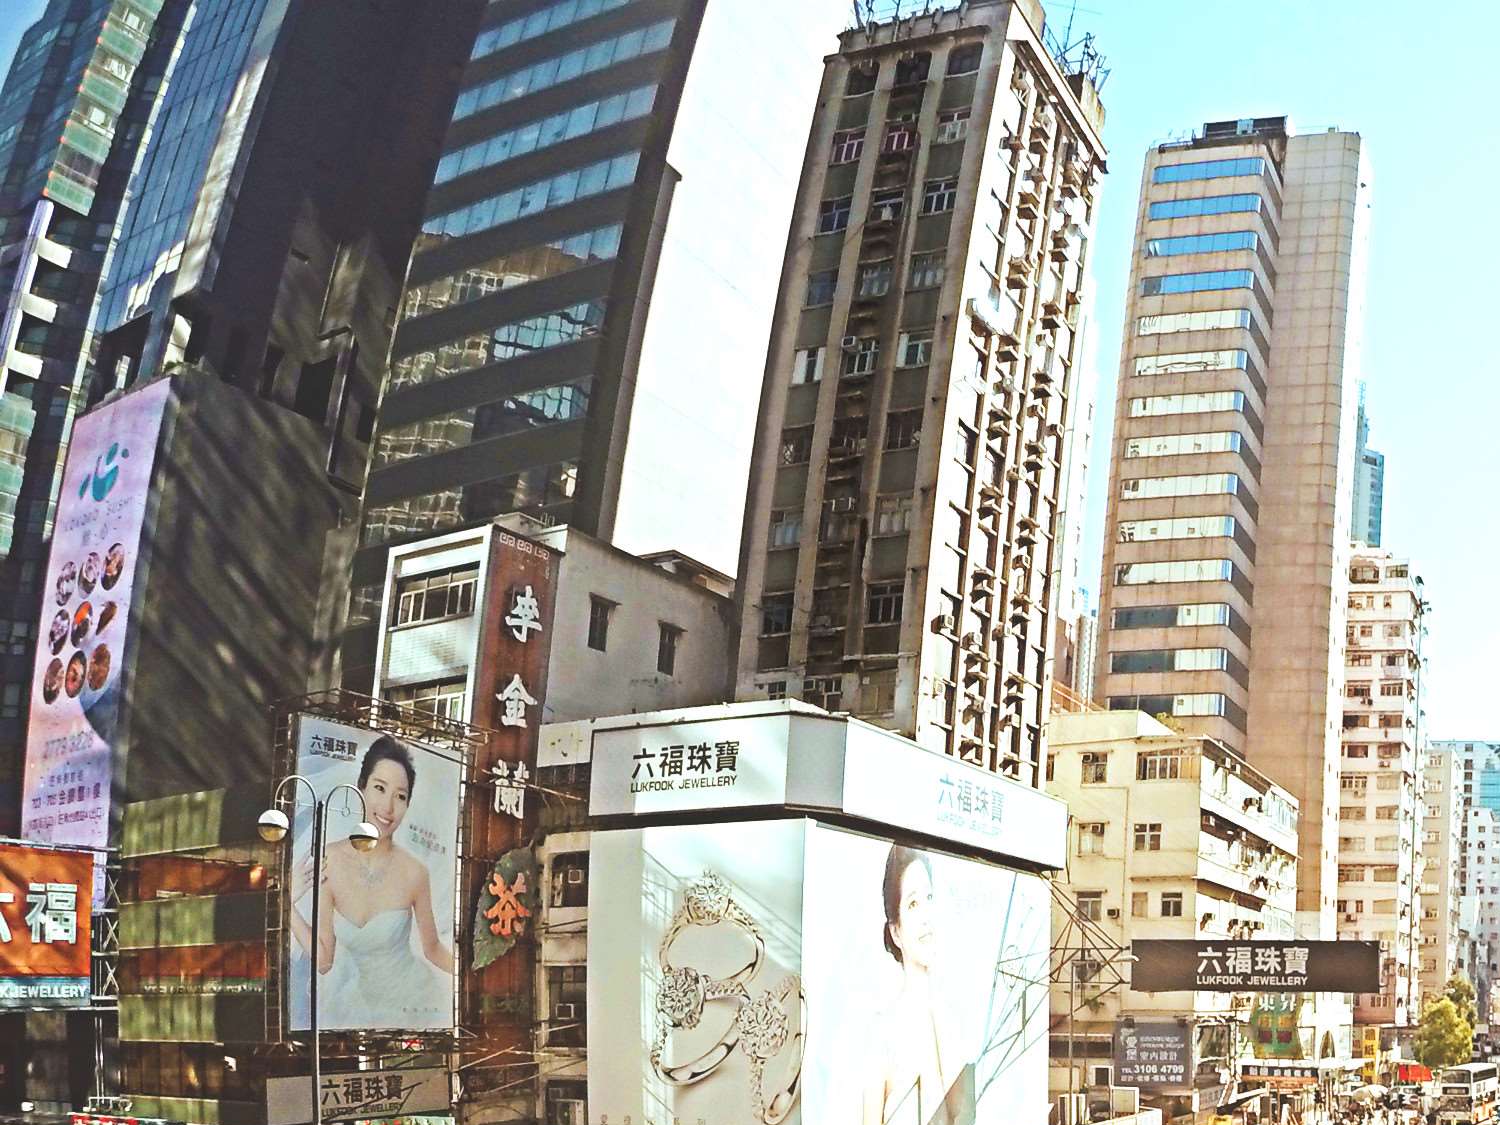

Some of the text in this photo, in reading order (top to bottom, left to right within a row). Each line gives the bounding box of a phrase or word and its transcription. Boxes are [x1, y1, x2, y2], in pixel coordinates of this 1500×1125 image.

[492, 586, 542, 820] 李金蘭
[310, 734, 358, 756] 六福珠寶
[631, 740, 740, 779] 六福珠寶
[630, 775, 738, 793] LUKFOOK JEWELLERY
[938, 772, 1004, 824] 六福珠寶
[1197, 946, 1309, 975] 六福珠寶
[12, 984, 87, 998] JEWELLERY
[1196, 975, 1308, 986] LUKFOOK JEWELLERY
[321, 1075, 403, 1105] 六福珠寶
